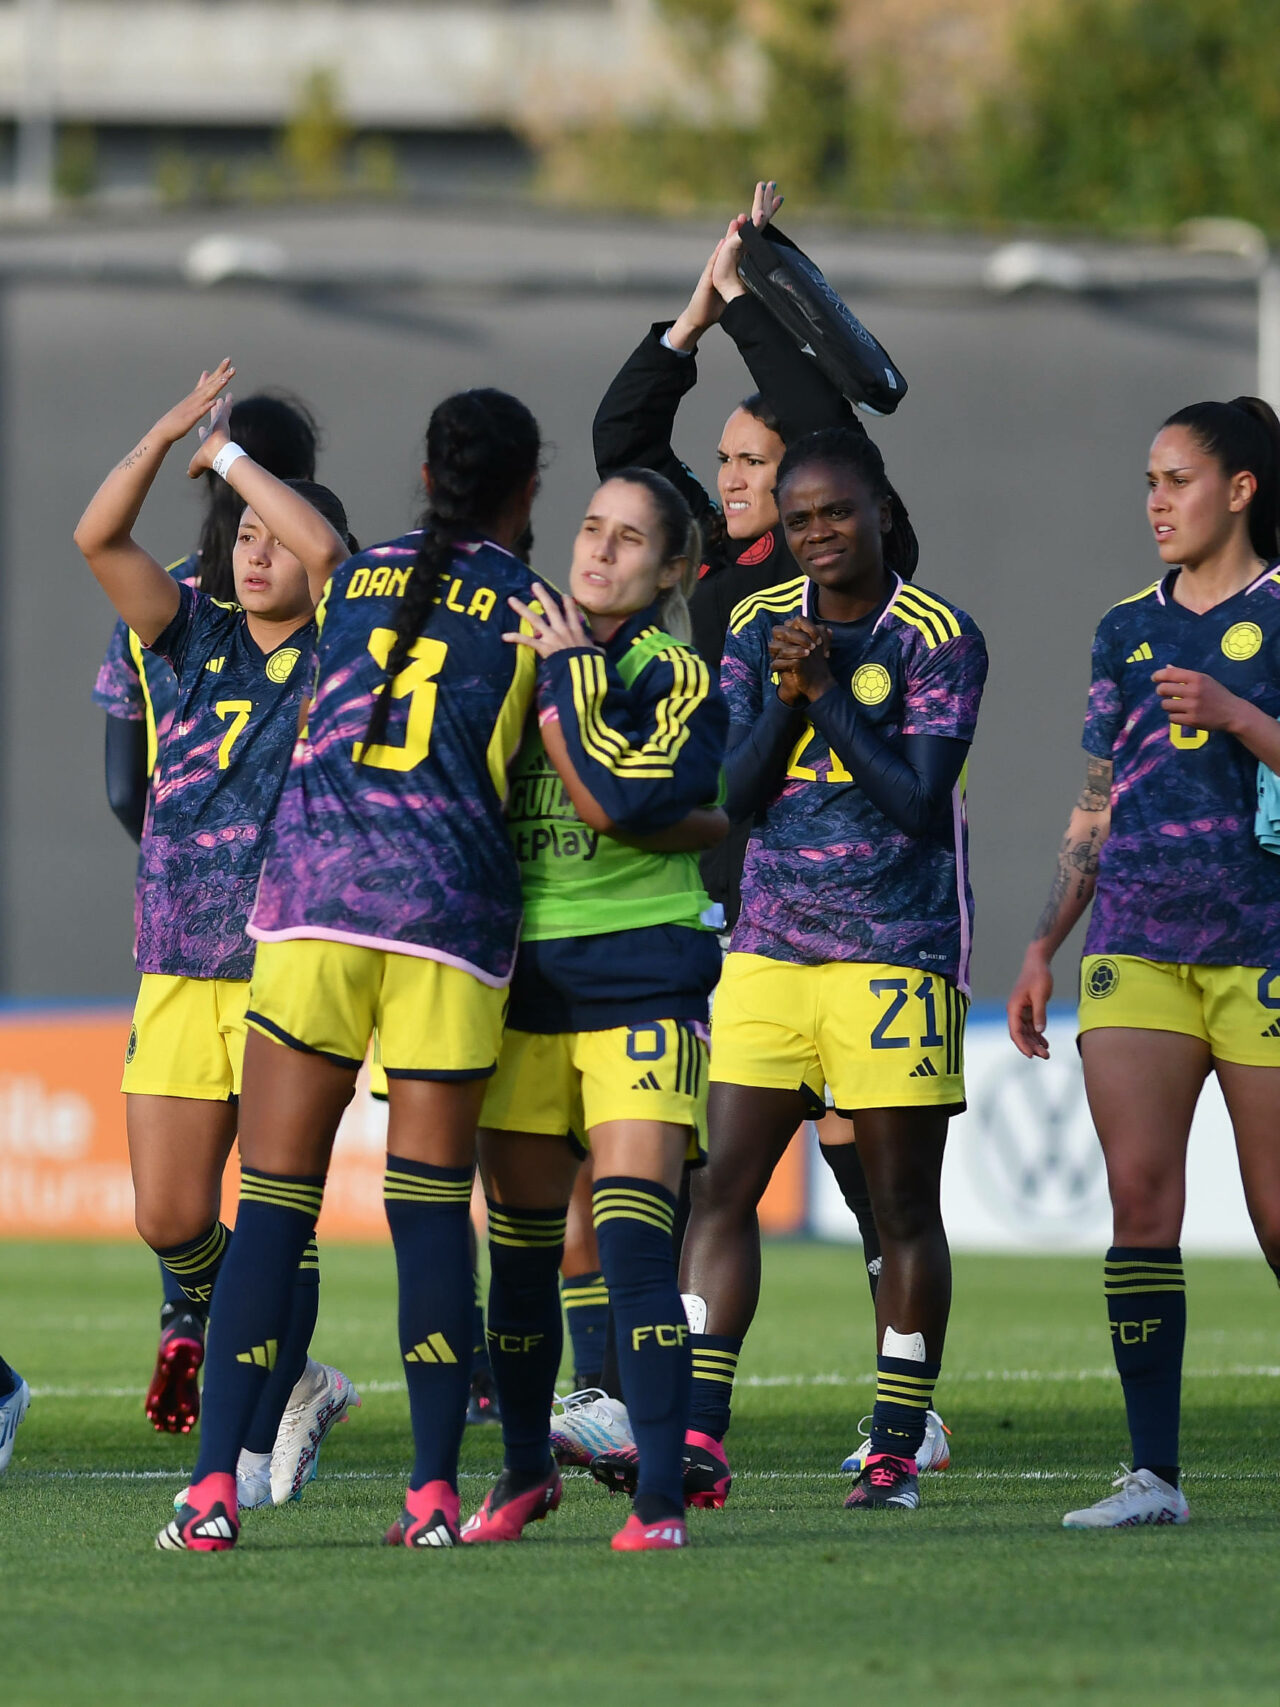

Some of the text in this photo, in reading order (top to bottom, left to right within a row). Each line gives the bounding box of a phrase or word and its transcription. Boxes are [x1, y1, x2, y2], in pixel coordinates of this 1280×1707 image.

[215, 700, 253, 770] 7
[351, 627, 448, 772] 3
[869, 976, 944, 1049] 21
[632, 1324, 689, 1351] FCF
